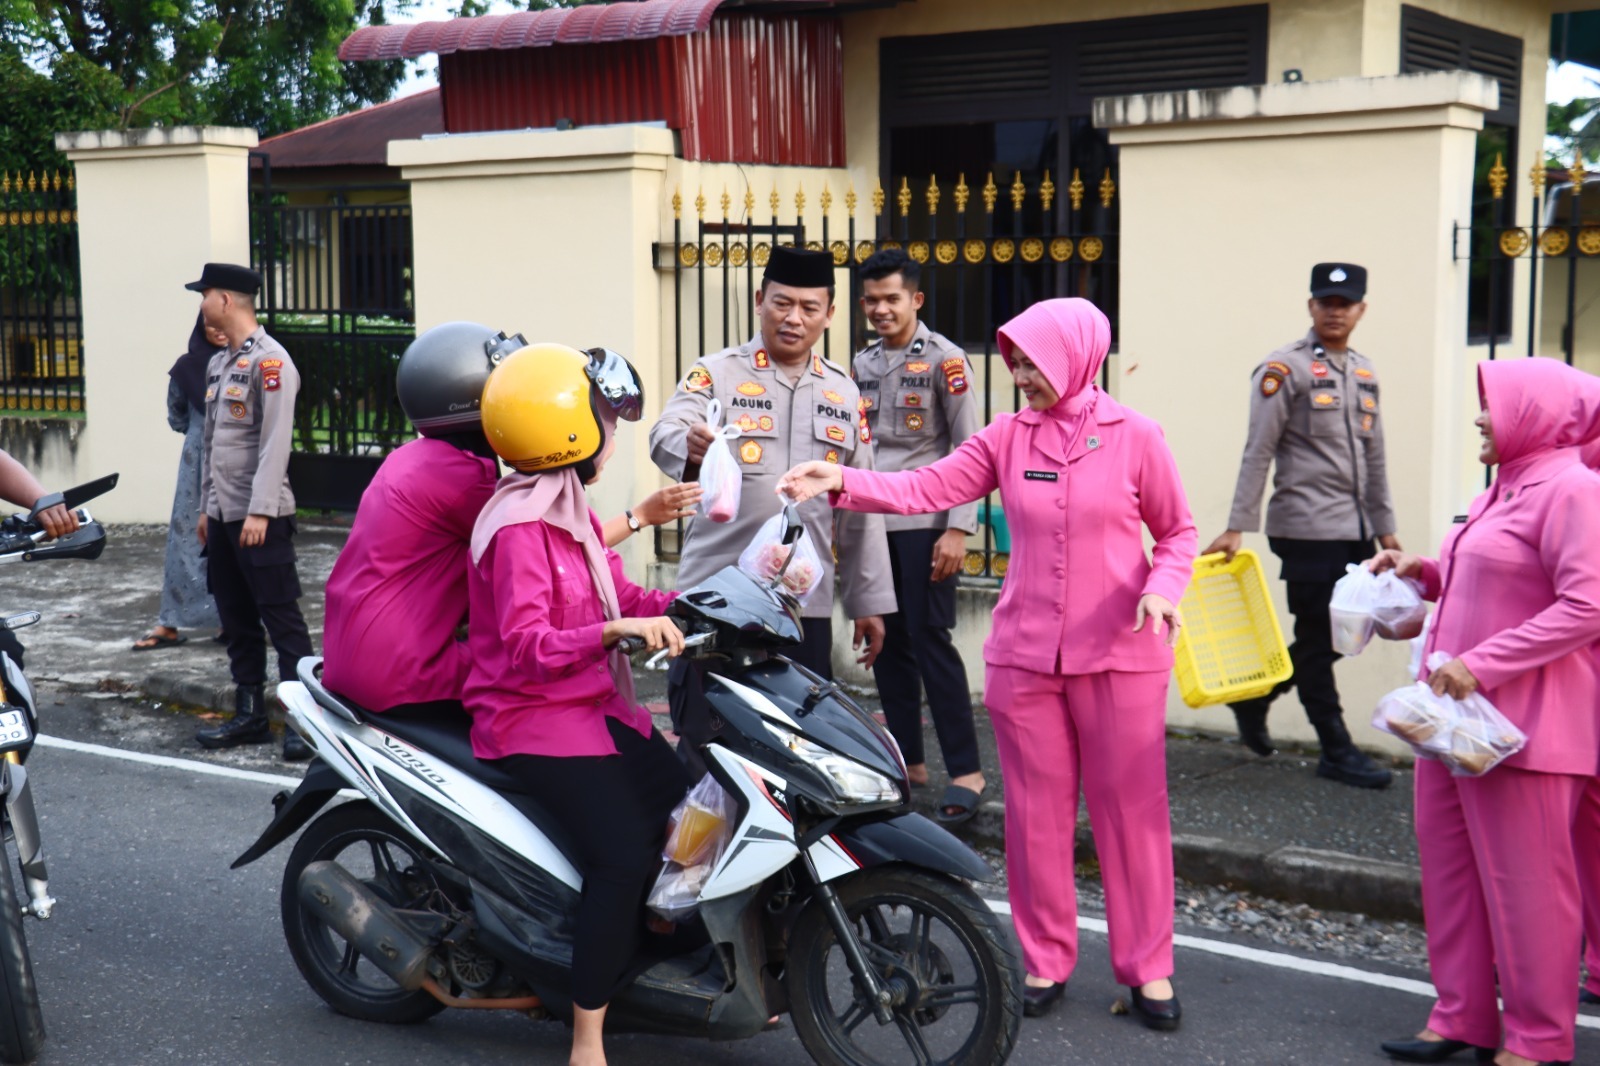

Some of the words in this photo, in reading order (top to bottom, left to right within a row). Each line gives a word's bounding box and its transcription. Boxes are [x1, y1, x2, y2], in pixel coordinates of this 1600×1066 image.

[900, 376, 931, 388] POLRI
[731, 397, 773, 411] AGUNG
[817, 404, 852, 422] POLRI
[543, 449, 582, 465] Retro
[384, 734, 449, 784] VARIO
